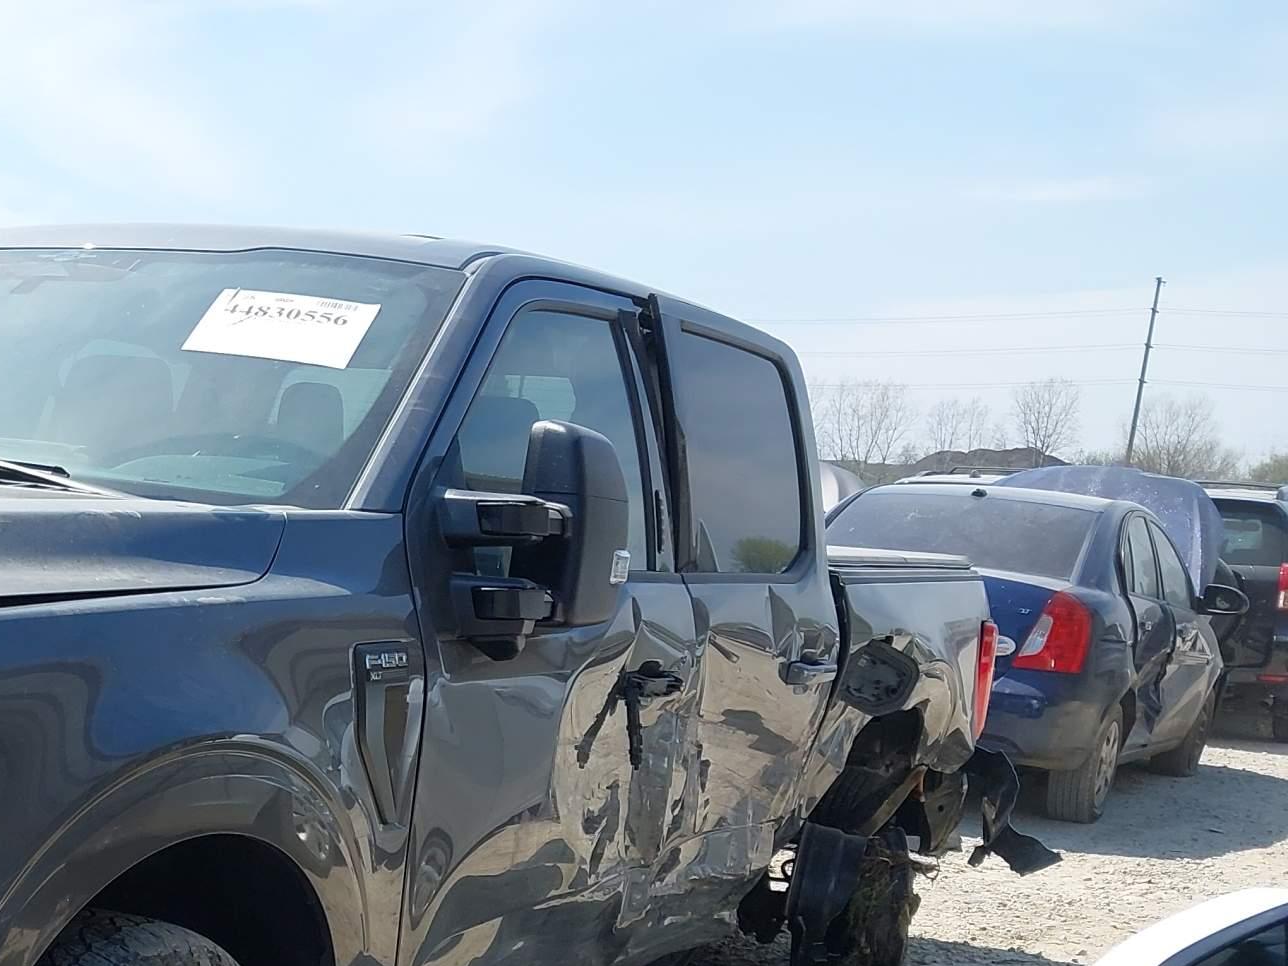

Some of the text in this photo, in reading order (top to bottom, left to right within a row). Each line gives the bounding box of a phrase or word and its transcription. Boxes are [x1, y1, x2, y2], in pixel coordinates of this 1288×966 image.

[224, 303, 349, 326] 44830556
[366, 653, 408, 669] F-150
[370, 671, 382, 681] XLT
